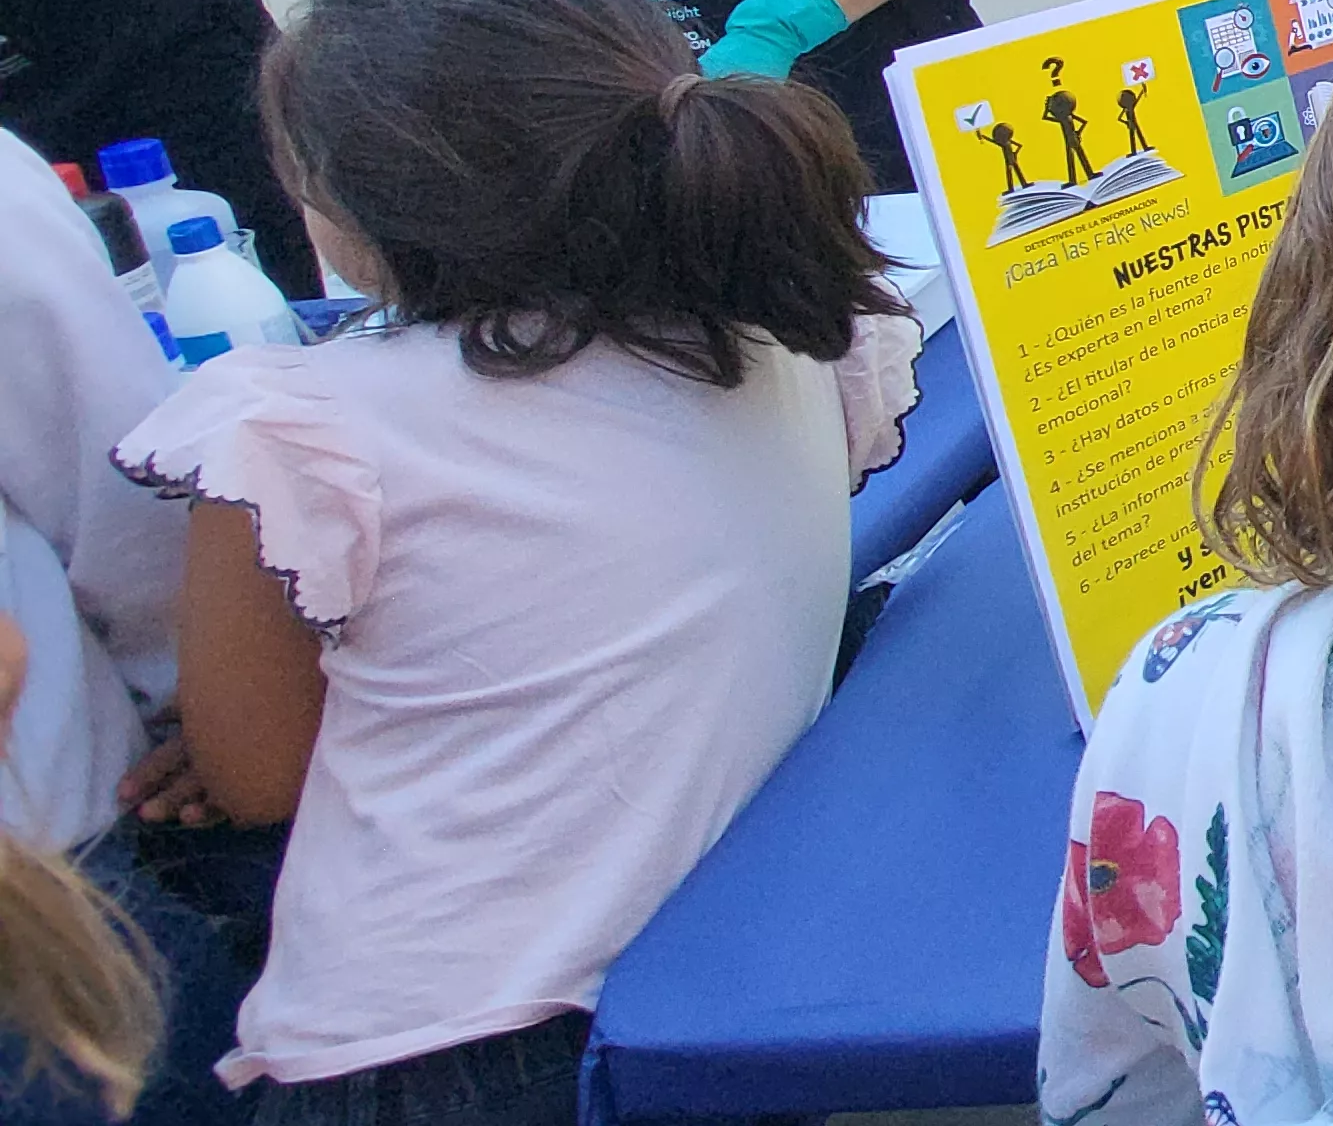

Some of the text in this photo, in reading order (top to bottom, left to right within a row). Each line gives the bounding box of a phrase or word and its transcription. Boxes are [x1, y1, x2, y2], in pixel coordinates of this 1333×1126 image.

[1005, 198, 1191, 290] ¡Caza las Fake News!
[1024, 197, 1158, 253] DETECTIVES DE LA INFORMACIÓN
[1112, 222, 1232, 290] NUESTRAS
[1018, 344, 1029, 359] 1
[1045, 313, 1105, 348] ¿Quién
[1109, 303, 1128, 319] es
[1130, 296, 1145, 311] la
[1149, 272, 1199, 303] fuente
[1203, 261, 1221, 279] de
[1224, 256, 1238, 269] la
[1024, 287, 1213, 383] ¿Es experta en el tema?
[1029, 304, 1249, 413] 2 ¿El titular de la noticia es
[1037, 379, 1132, 436] emocional?
[1043, 371, 1217, 465] 3 ¿Hay datos o cifras
[1050, 480, 1061, 495] 4
[1077, 460, 1106, 484] ¿Se
[1110, 420, 1186, 466] menciona
[1056, 455, 1166, 519] institución de
[1065, 531, 1077, 547] 5
[1092, 510, 1119, 534] ¿La
[1072, 513, 1151, 568] del tema?
[1079, 522, 1199, 594] 6 ¿Parece una
[1177, 545, 1193, 571] y
[1178, 564, 1227, 608] ¡ven
